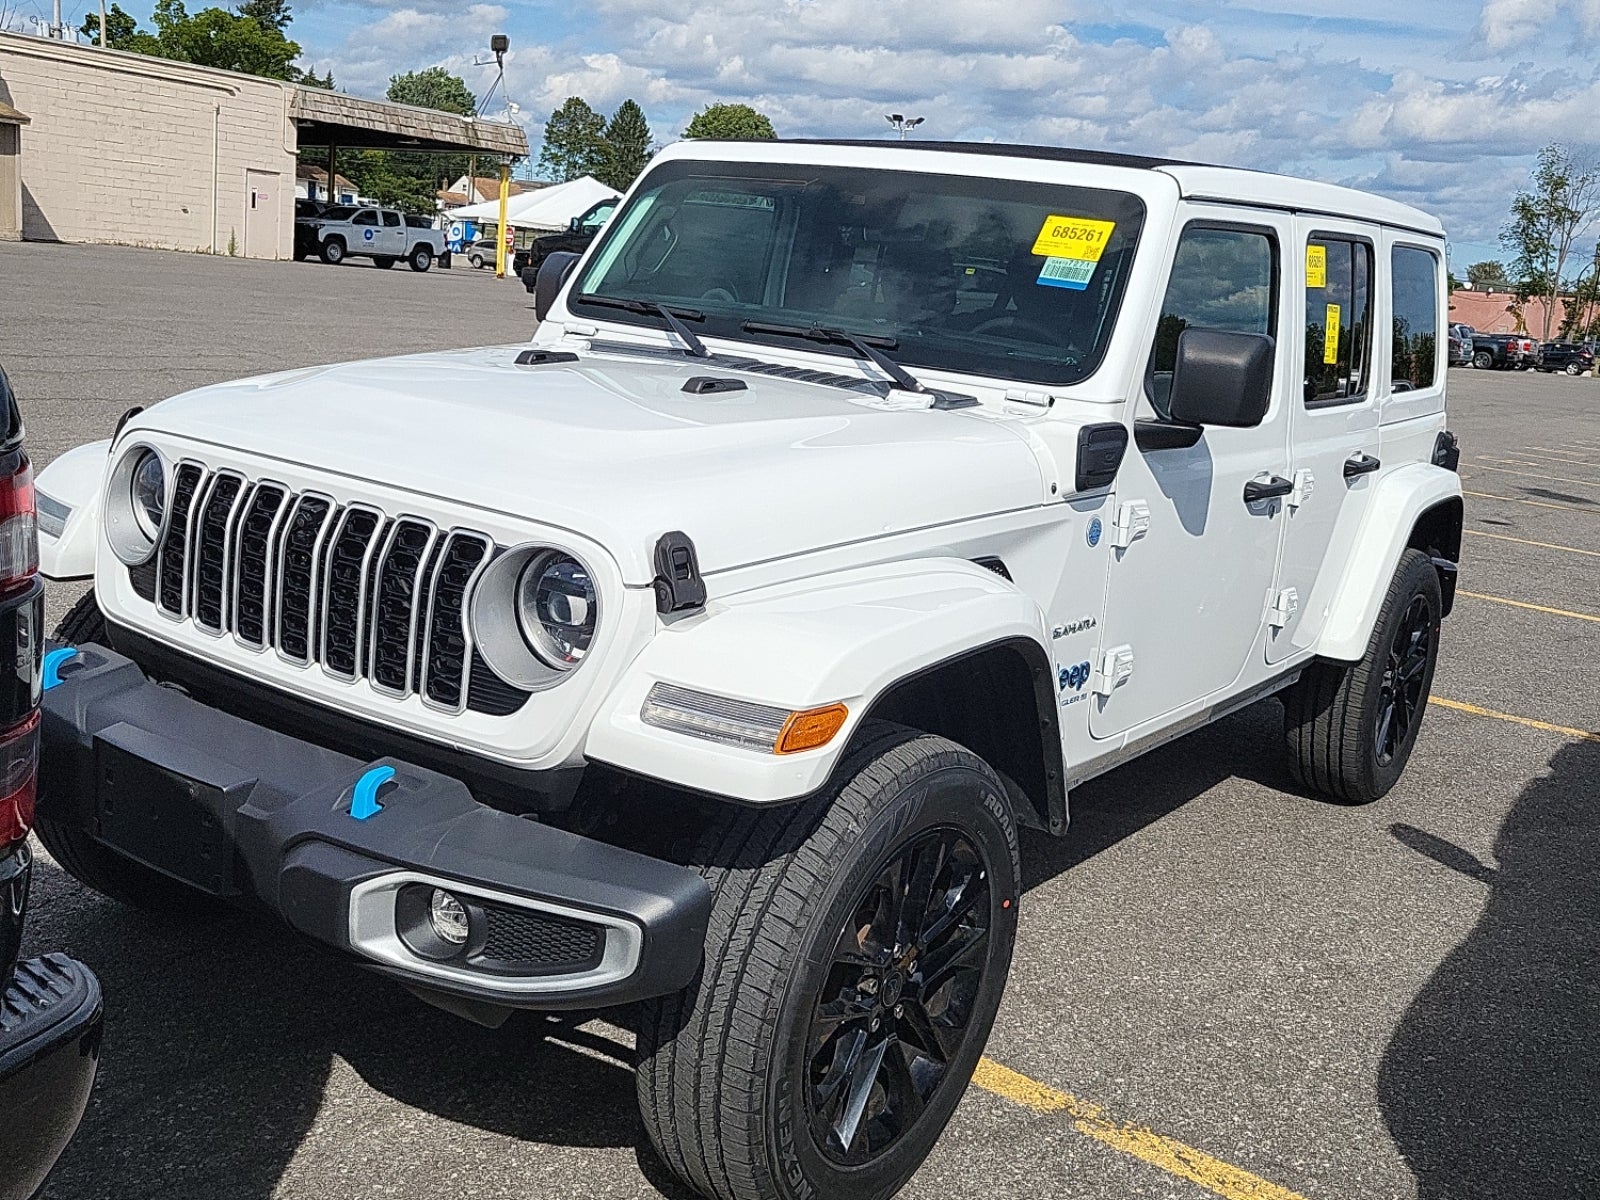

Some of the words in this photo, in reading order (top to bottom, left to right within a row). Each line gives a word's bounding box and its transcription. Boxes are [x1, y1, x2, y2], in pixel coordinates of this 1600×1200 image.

[1052, 226, 1103, 242] 685261
[1052, 617, 1097, 639] SAHARA
[779, 1094, 815, 1200] NEXEN
